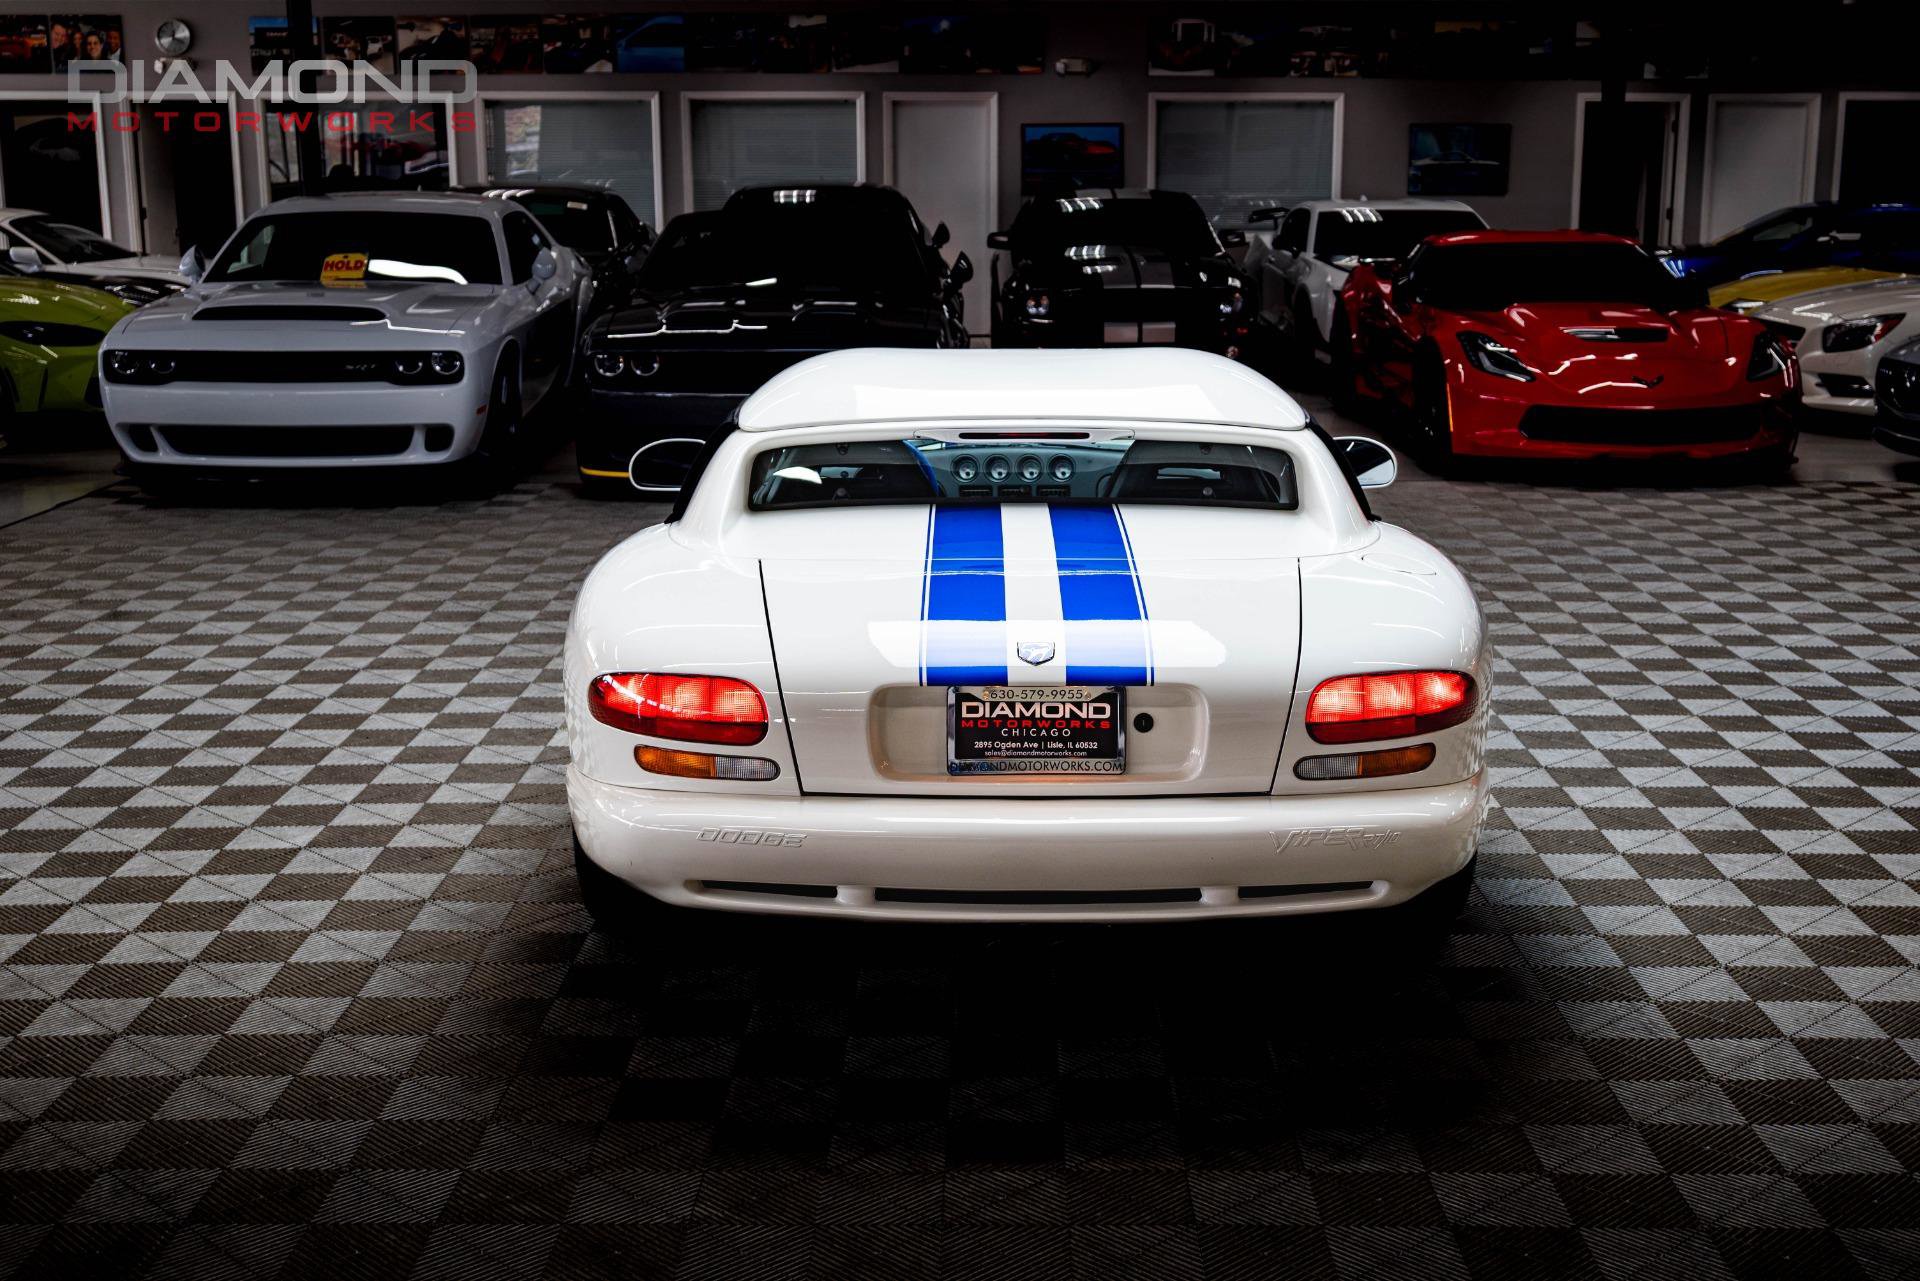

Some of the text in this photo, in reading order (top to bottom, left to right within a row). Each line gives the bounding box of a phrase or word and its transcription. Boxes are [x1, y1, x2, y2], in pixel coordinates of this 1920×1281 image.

[323, 260, 364, 272] HOLD
[990, 689, 1083, 700] 630-579-9955
[961, 701, 1111, 719] DIAMOND
[961, 719, 1112, 729] MOTORWORKS
[1001, 728, 1071, 737] CHICAGO
[974, 741, 993, 749] 2895
[994, 741, 1021, 750] Ogden
[1023, 741, 1039, 749] Ave
[1047, 741, 1066, 749] Lisle,
[1067, 741, 1074, 749] IL
[1075, 741, 1098, 749] 60532
[696, 827, 807, 848] DODGE
